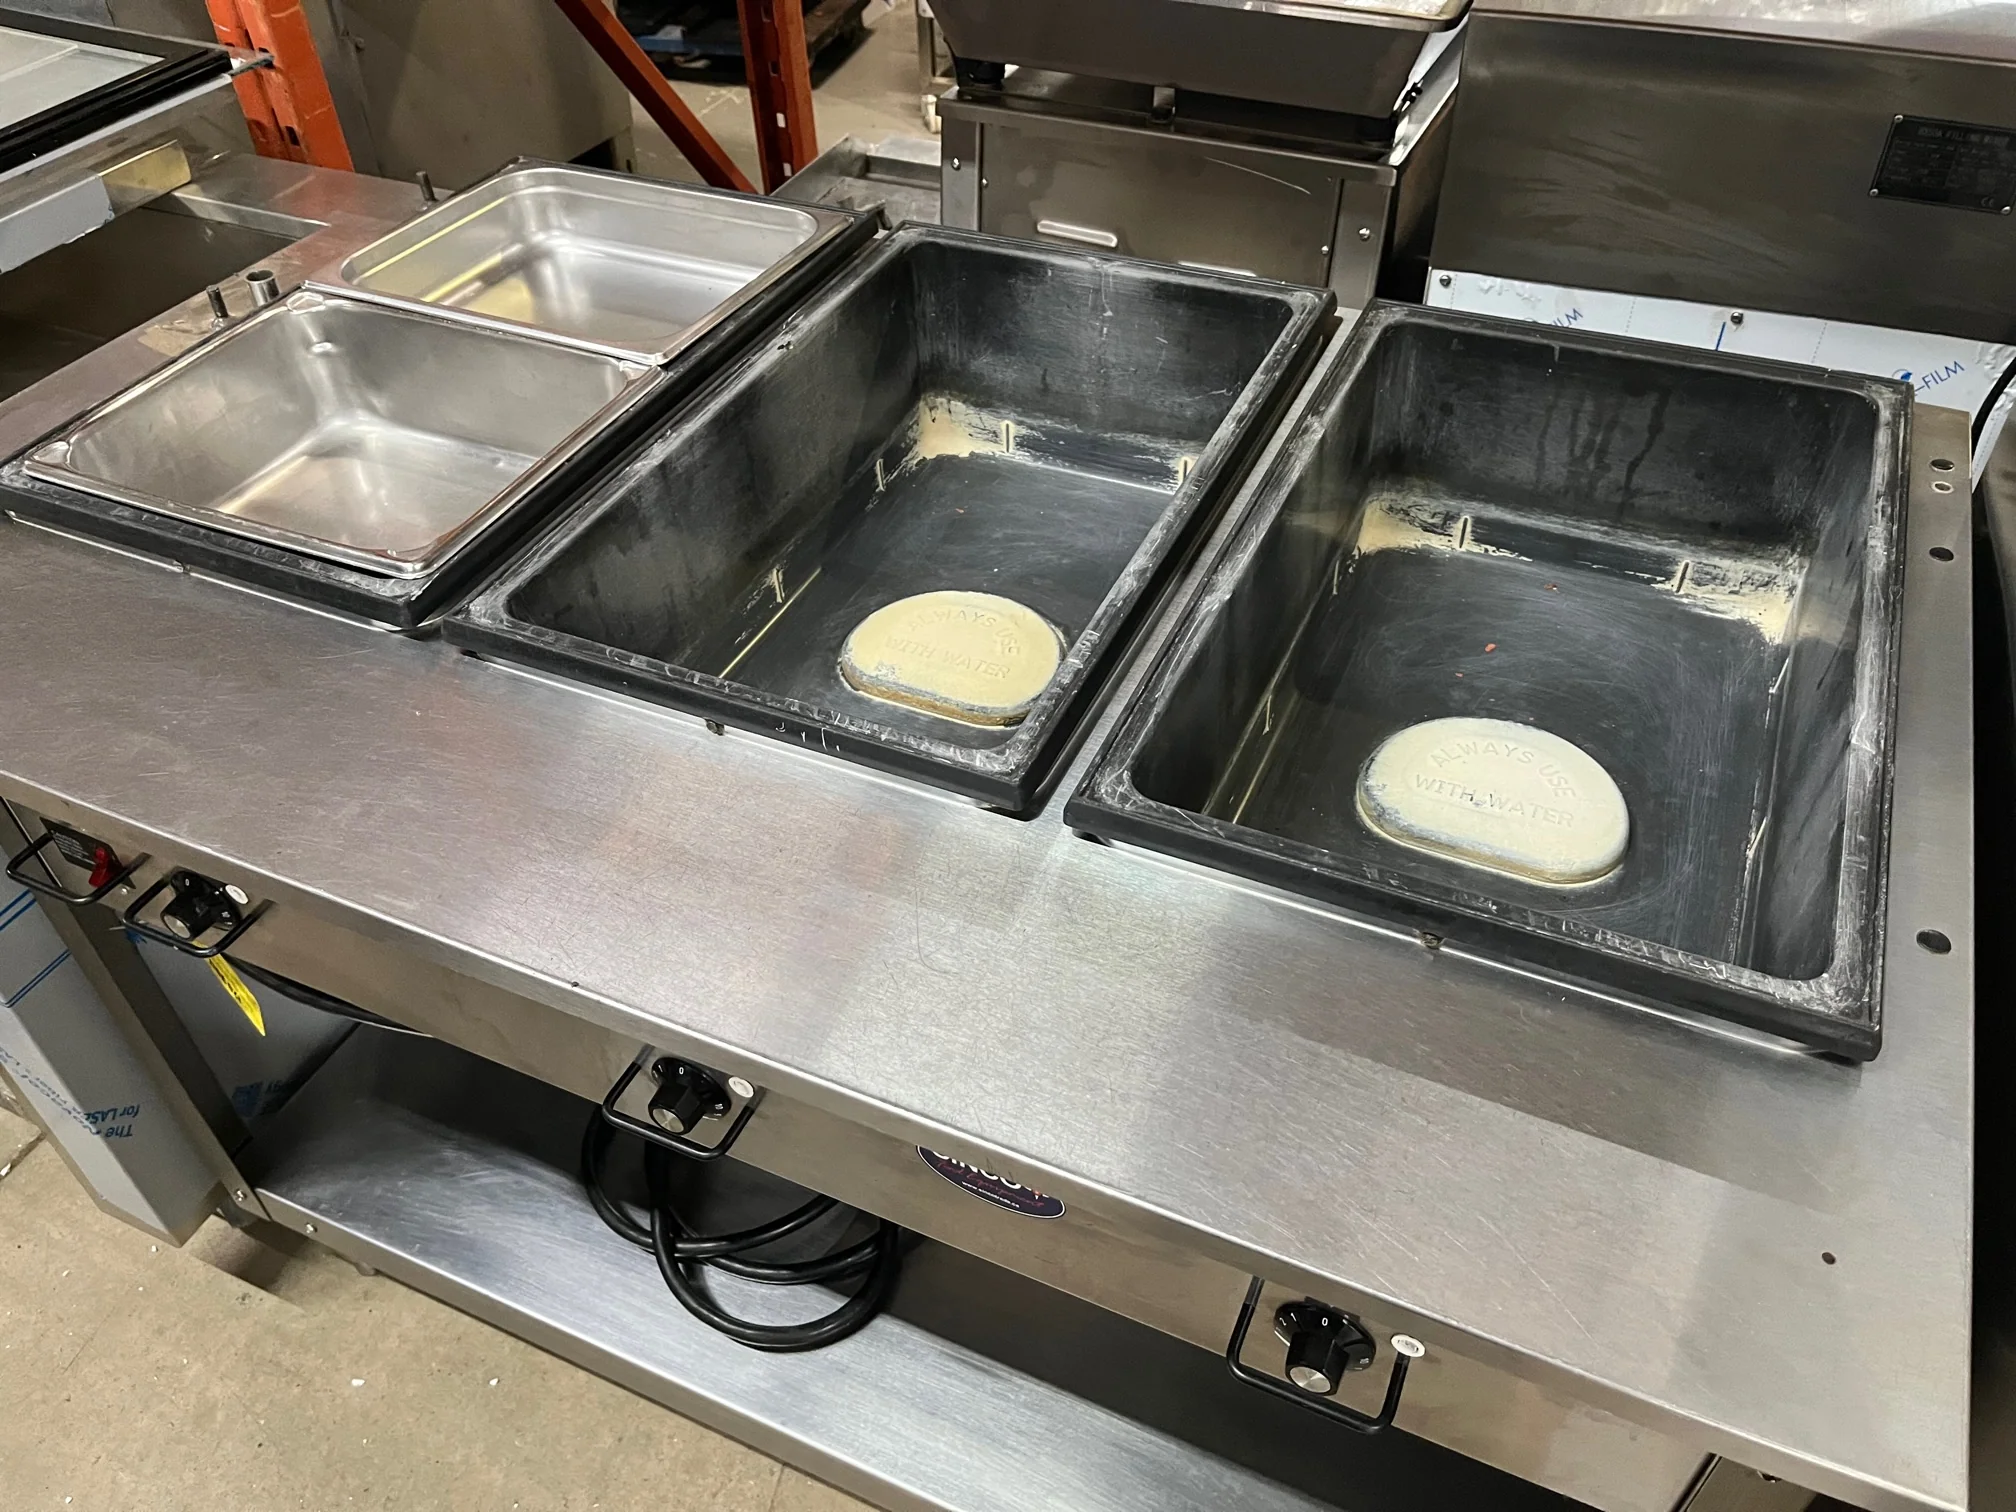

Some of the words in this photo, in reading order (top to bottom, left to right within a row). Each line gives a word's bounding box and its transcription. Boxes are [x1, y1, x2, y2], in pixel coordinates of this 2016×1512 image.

[908, 609, 997, 633] ALWAYS
[885, 635, 935, 660] WITH
[942, 651, 1012, 680] WATER
[1429, 740, 1535, 768] ALWAYS
[1538, 762, 1577, 799] USE
[1415, 774, 1475, 803] WITH
[1489, 792, 1575, 828] WATER
[104, 1123, 133, 1138] The
[1321, 1316, 1329, 1327] 0
